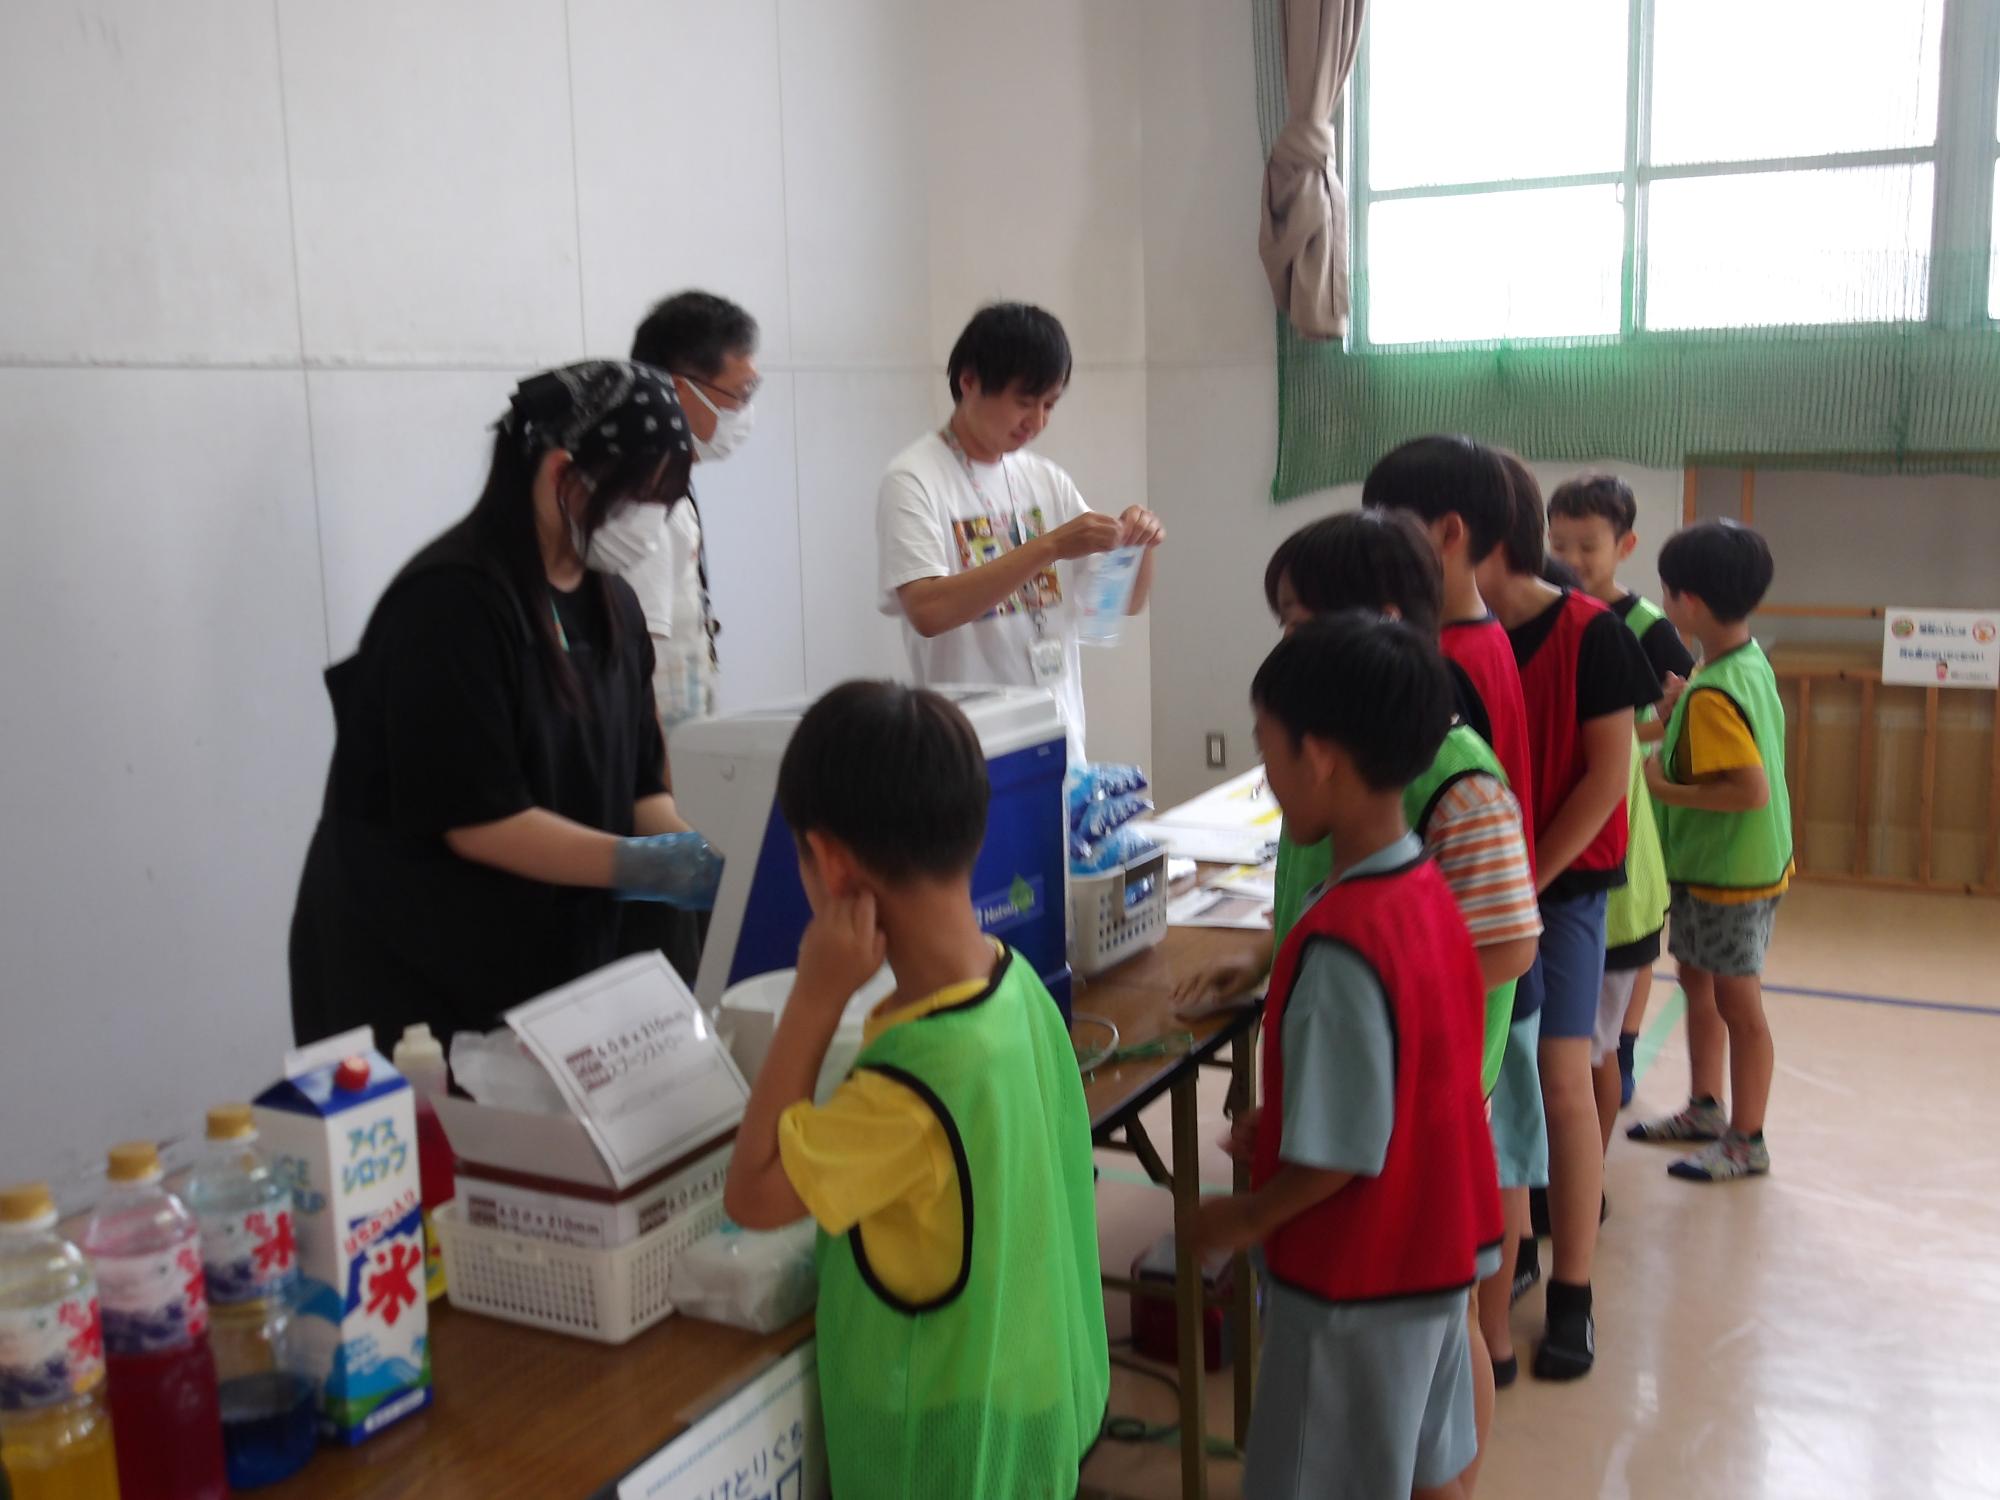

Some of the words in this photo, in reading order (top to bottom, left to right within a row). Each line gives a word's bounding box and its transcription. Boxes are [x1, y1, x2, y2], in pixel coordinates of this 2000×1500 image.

[347, 1118, 396, 1159] アイス
[343, 1141, 407, 1195] シロップ
[366, 1242, 421, 1326] 氷
